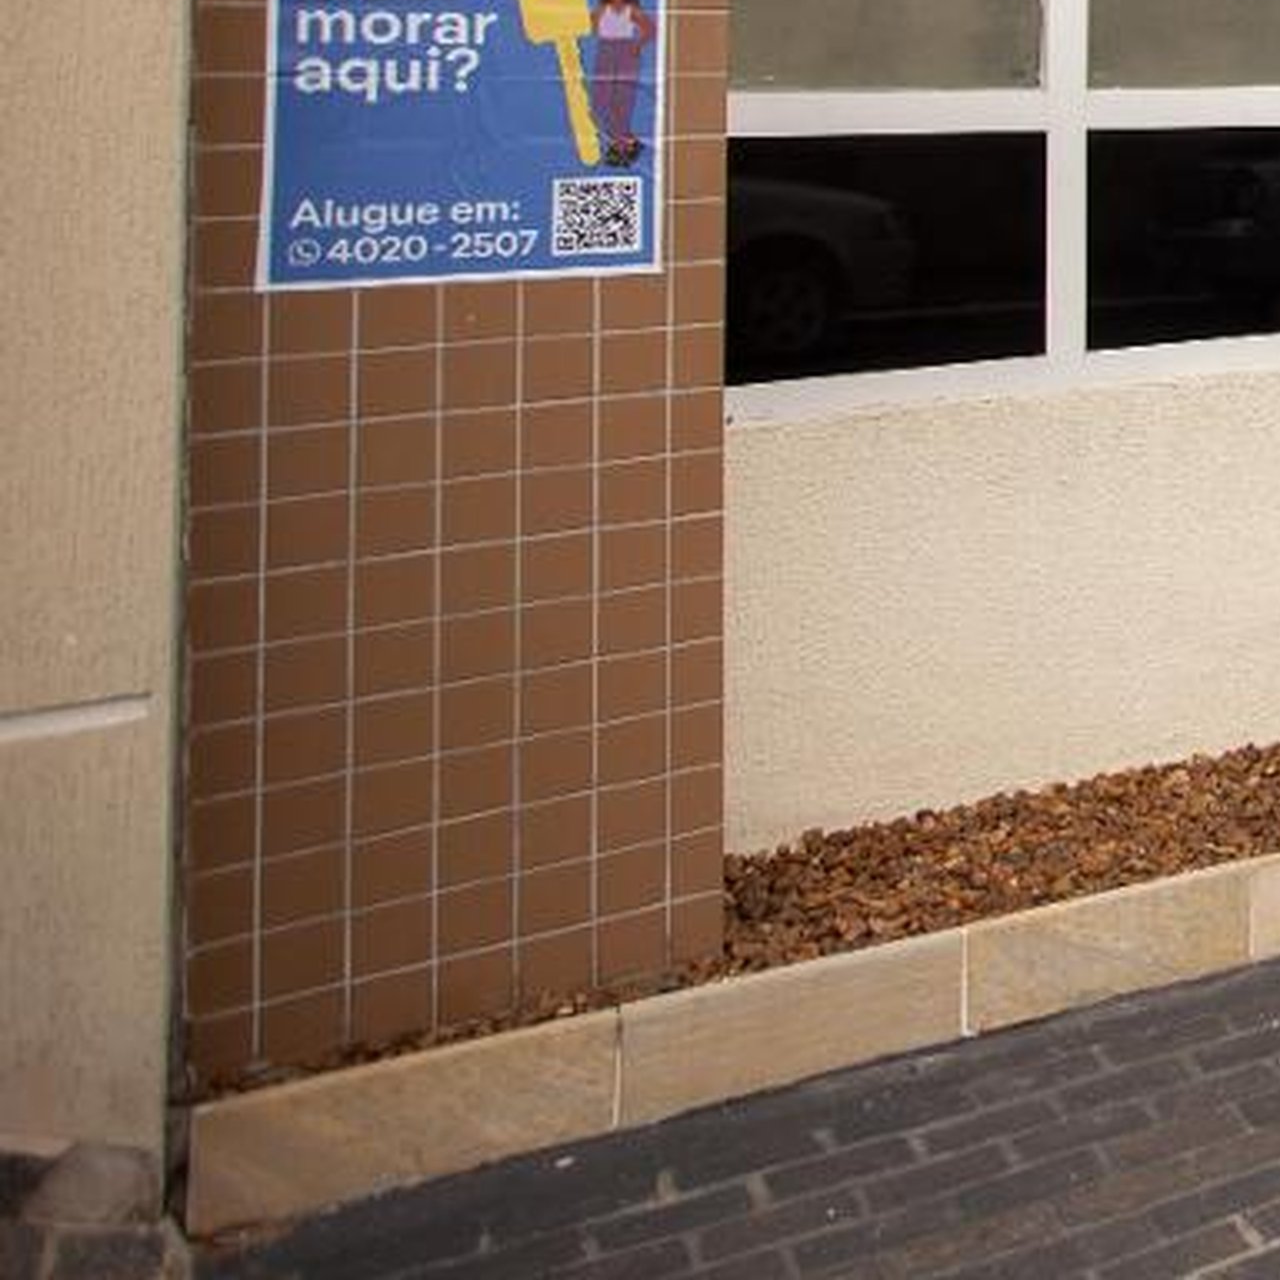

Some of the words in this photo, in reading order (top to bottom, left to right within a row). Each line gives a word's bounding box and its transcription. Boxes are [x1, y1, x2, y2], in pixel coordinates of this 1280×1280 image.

[297, 8, 497, 47] morar
[293, 47, 479, 102] aqui?
[290, 197, 439, 233] Alugue
[450, 200, 521, 222] em:
